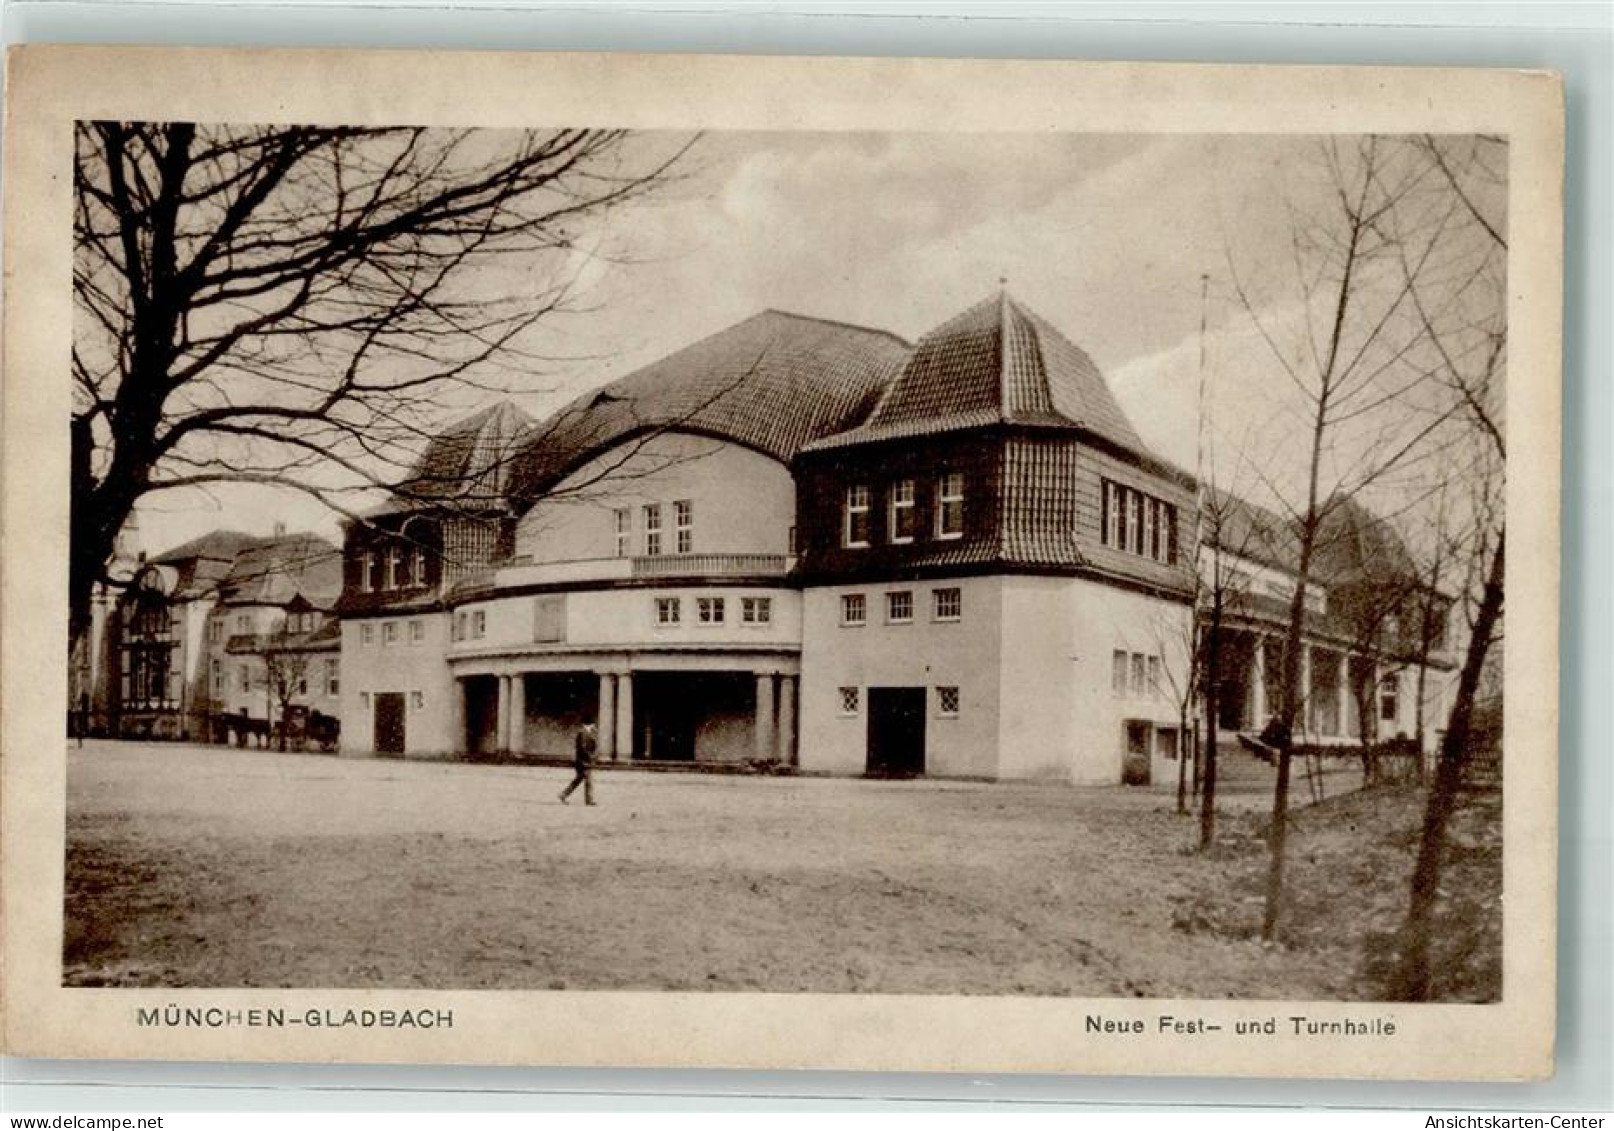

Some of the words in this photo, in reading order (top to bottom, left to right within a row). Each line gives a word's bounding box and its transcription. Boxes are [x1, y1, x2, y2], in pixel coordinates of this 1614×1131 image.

[137, 1003, 454, 1028] MÜNCHEN-GLADBACH
[1085, 1015, 1145, 1034] Neue
[1159, 1016, 1222, 1034] Fest-
[1235, 1017, 1277, 1035] und
[1289, 1017, 1396, 1036] Turnhalle
